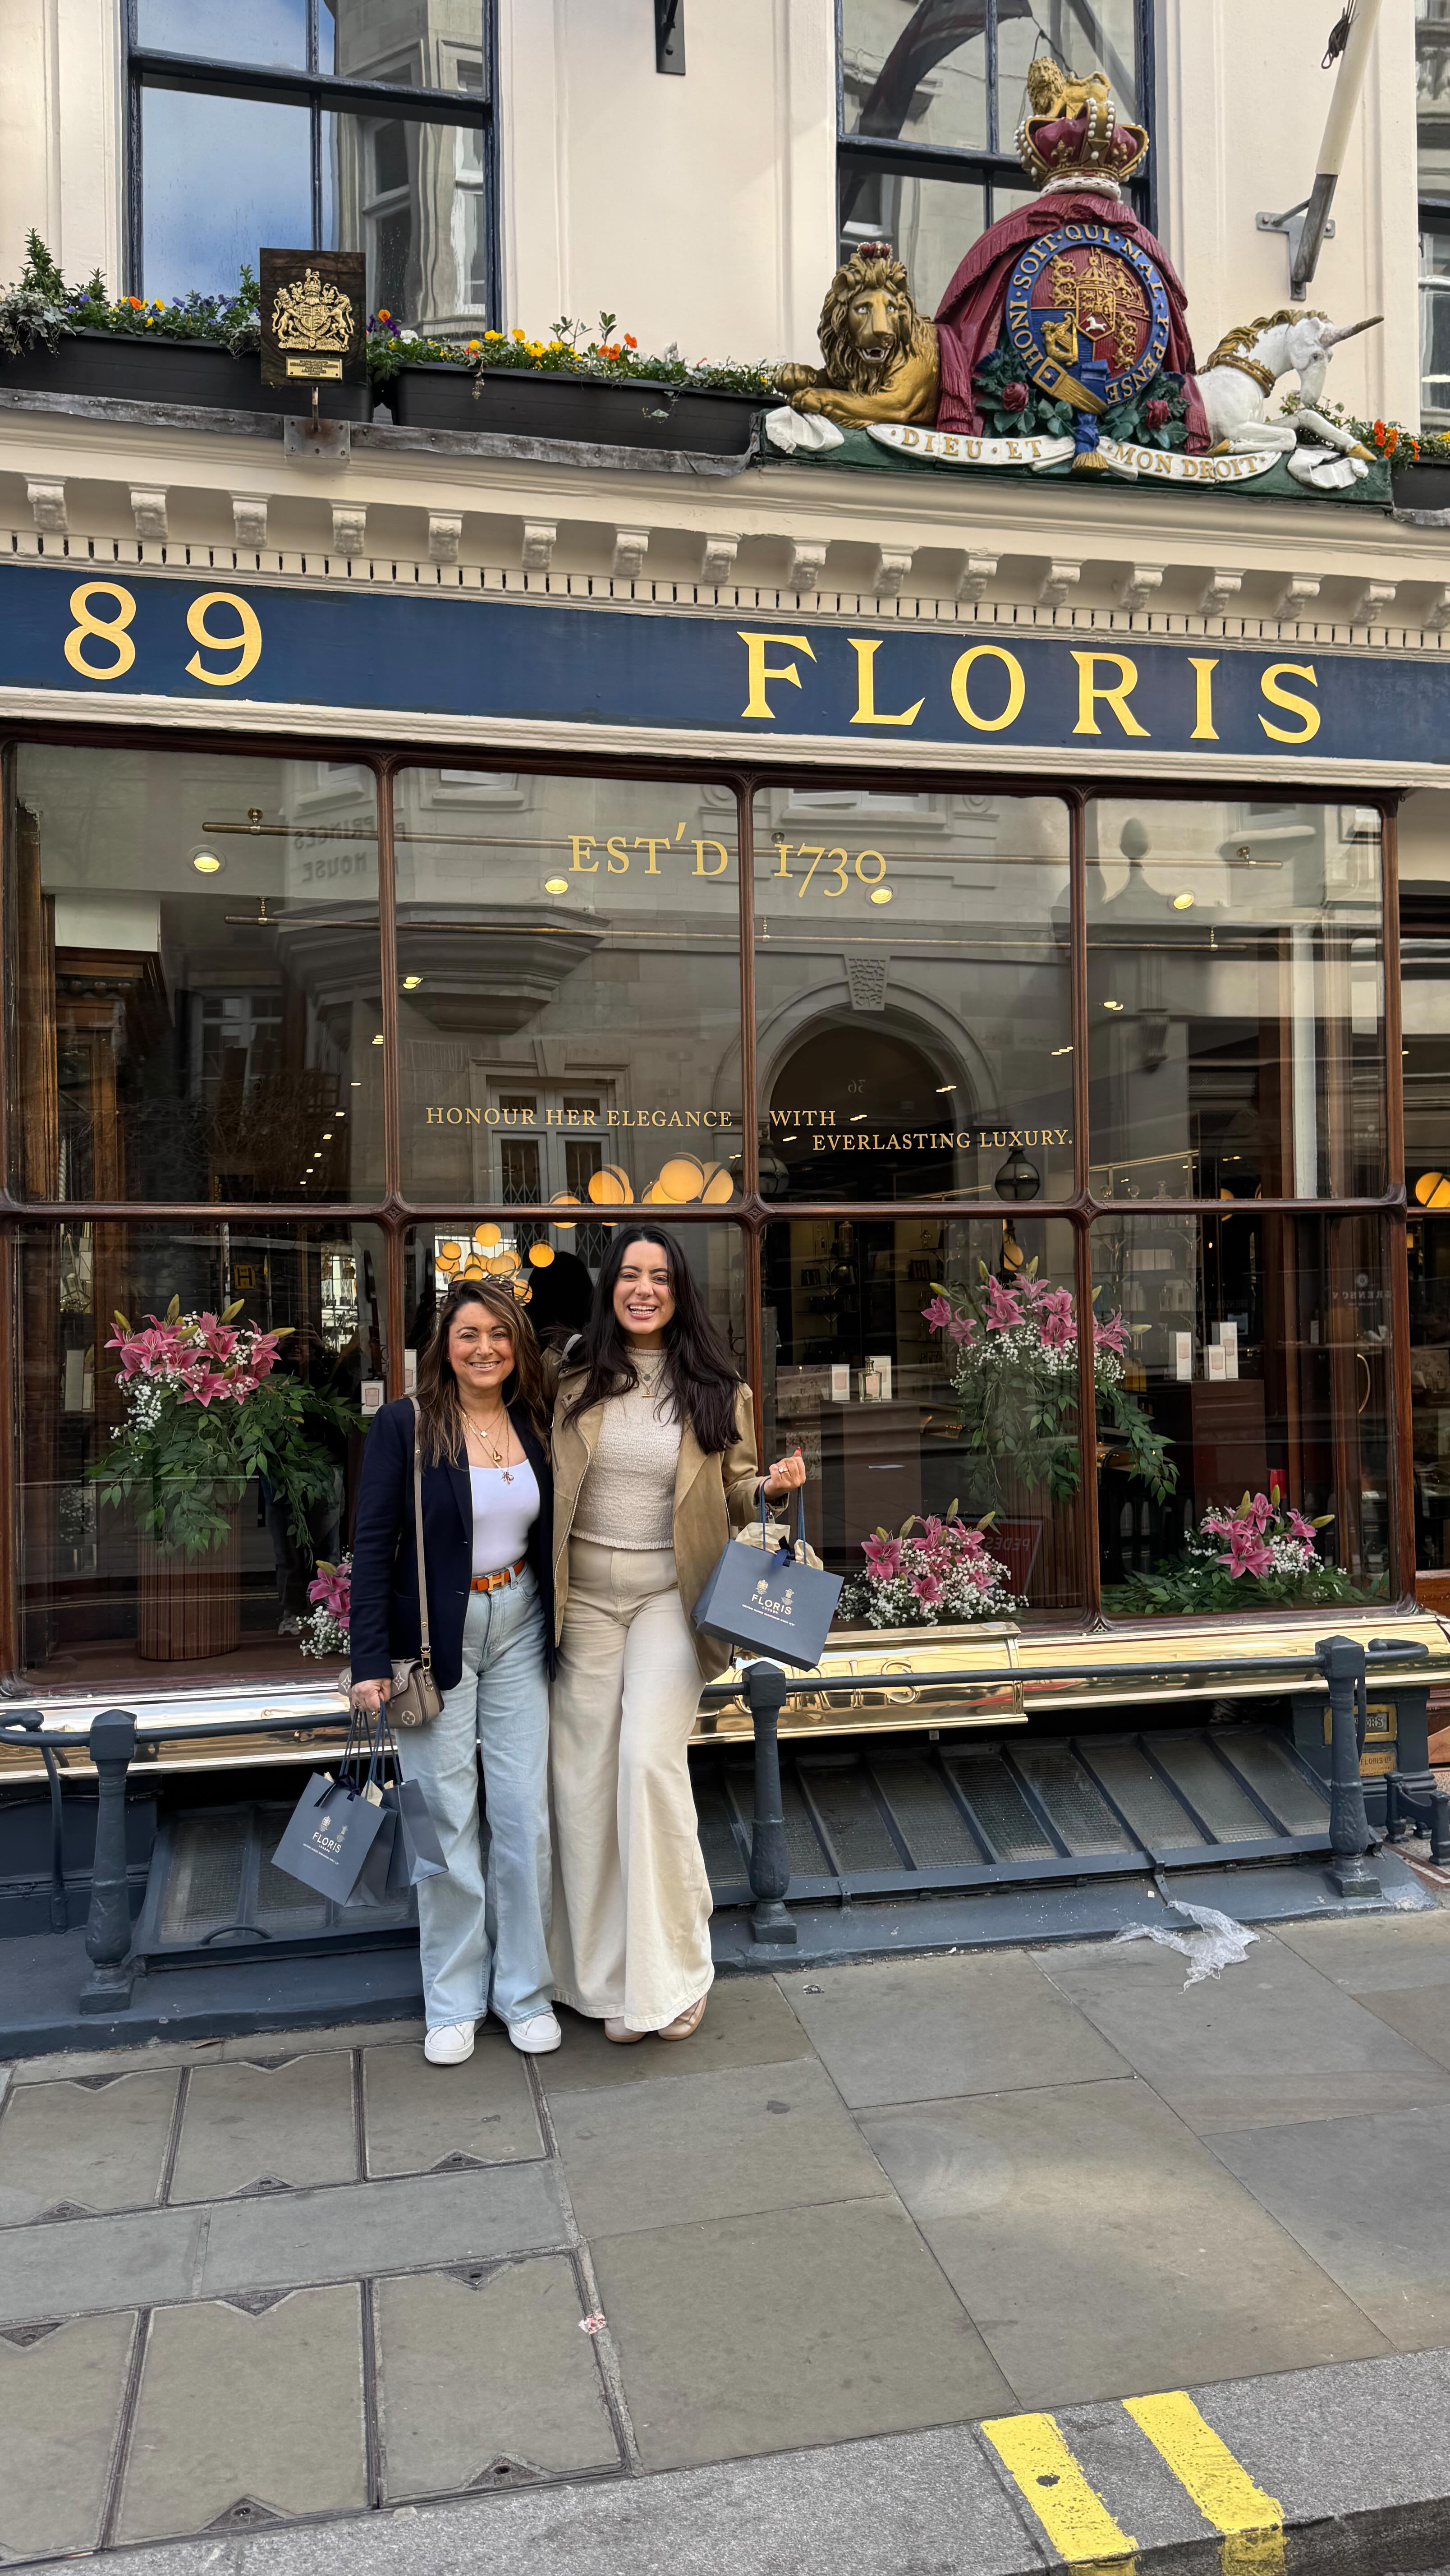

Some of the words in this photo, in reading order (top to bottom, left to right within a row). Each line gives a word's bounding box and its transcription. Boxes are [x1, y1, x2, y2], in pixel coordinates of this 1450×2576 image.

[1065, 225, 1110, 243] QUI
[1013, 234, 1058, 290] SOIT
[1121, 238, 1164, 298] MAL
[1009, 300, 1044, 369] HONI
[1157, 314, 1169, 333] Y
[1105, 340, 1166, 404] PENSE
[901, 428, 983, 459] DIEU
[1006, 439, 1042, 459] ET
[1113, 446, 1172, 474] MON
[1182, 455, 1260, 478] DROIT
[64, 581, 262, 686] 89
[737, 631, 1321, 744] FLORIS
[774, 842, 887, 898] 1730
[426, 1107, 537, 1125] HONOUR
[546, 1109, 598, 1126] HER
[607, 1110, 733, 1127] ELEGANCE
[769, 1110, 836, 1127] WITH
[812, 1132, 971, 1151] EVERLASTING
[979, 1129, 1074, 1148] LUXURY.
[751, 1594, 792, 1615] FLORIS
[312, 1831, 341, 1853] FLORIS
